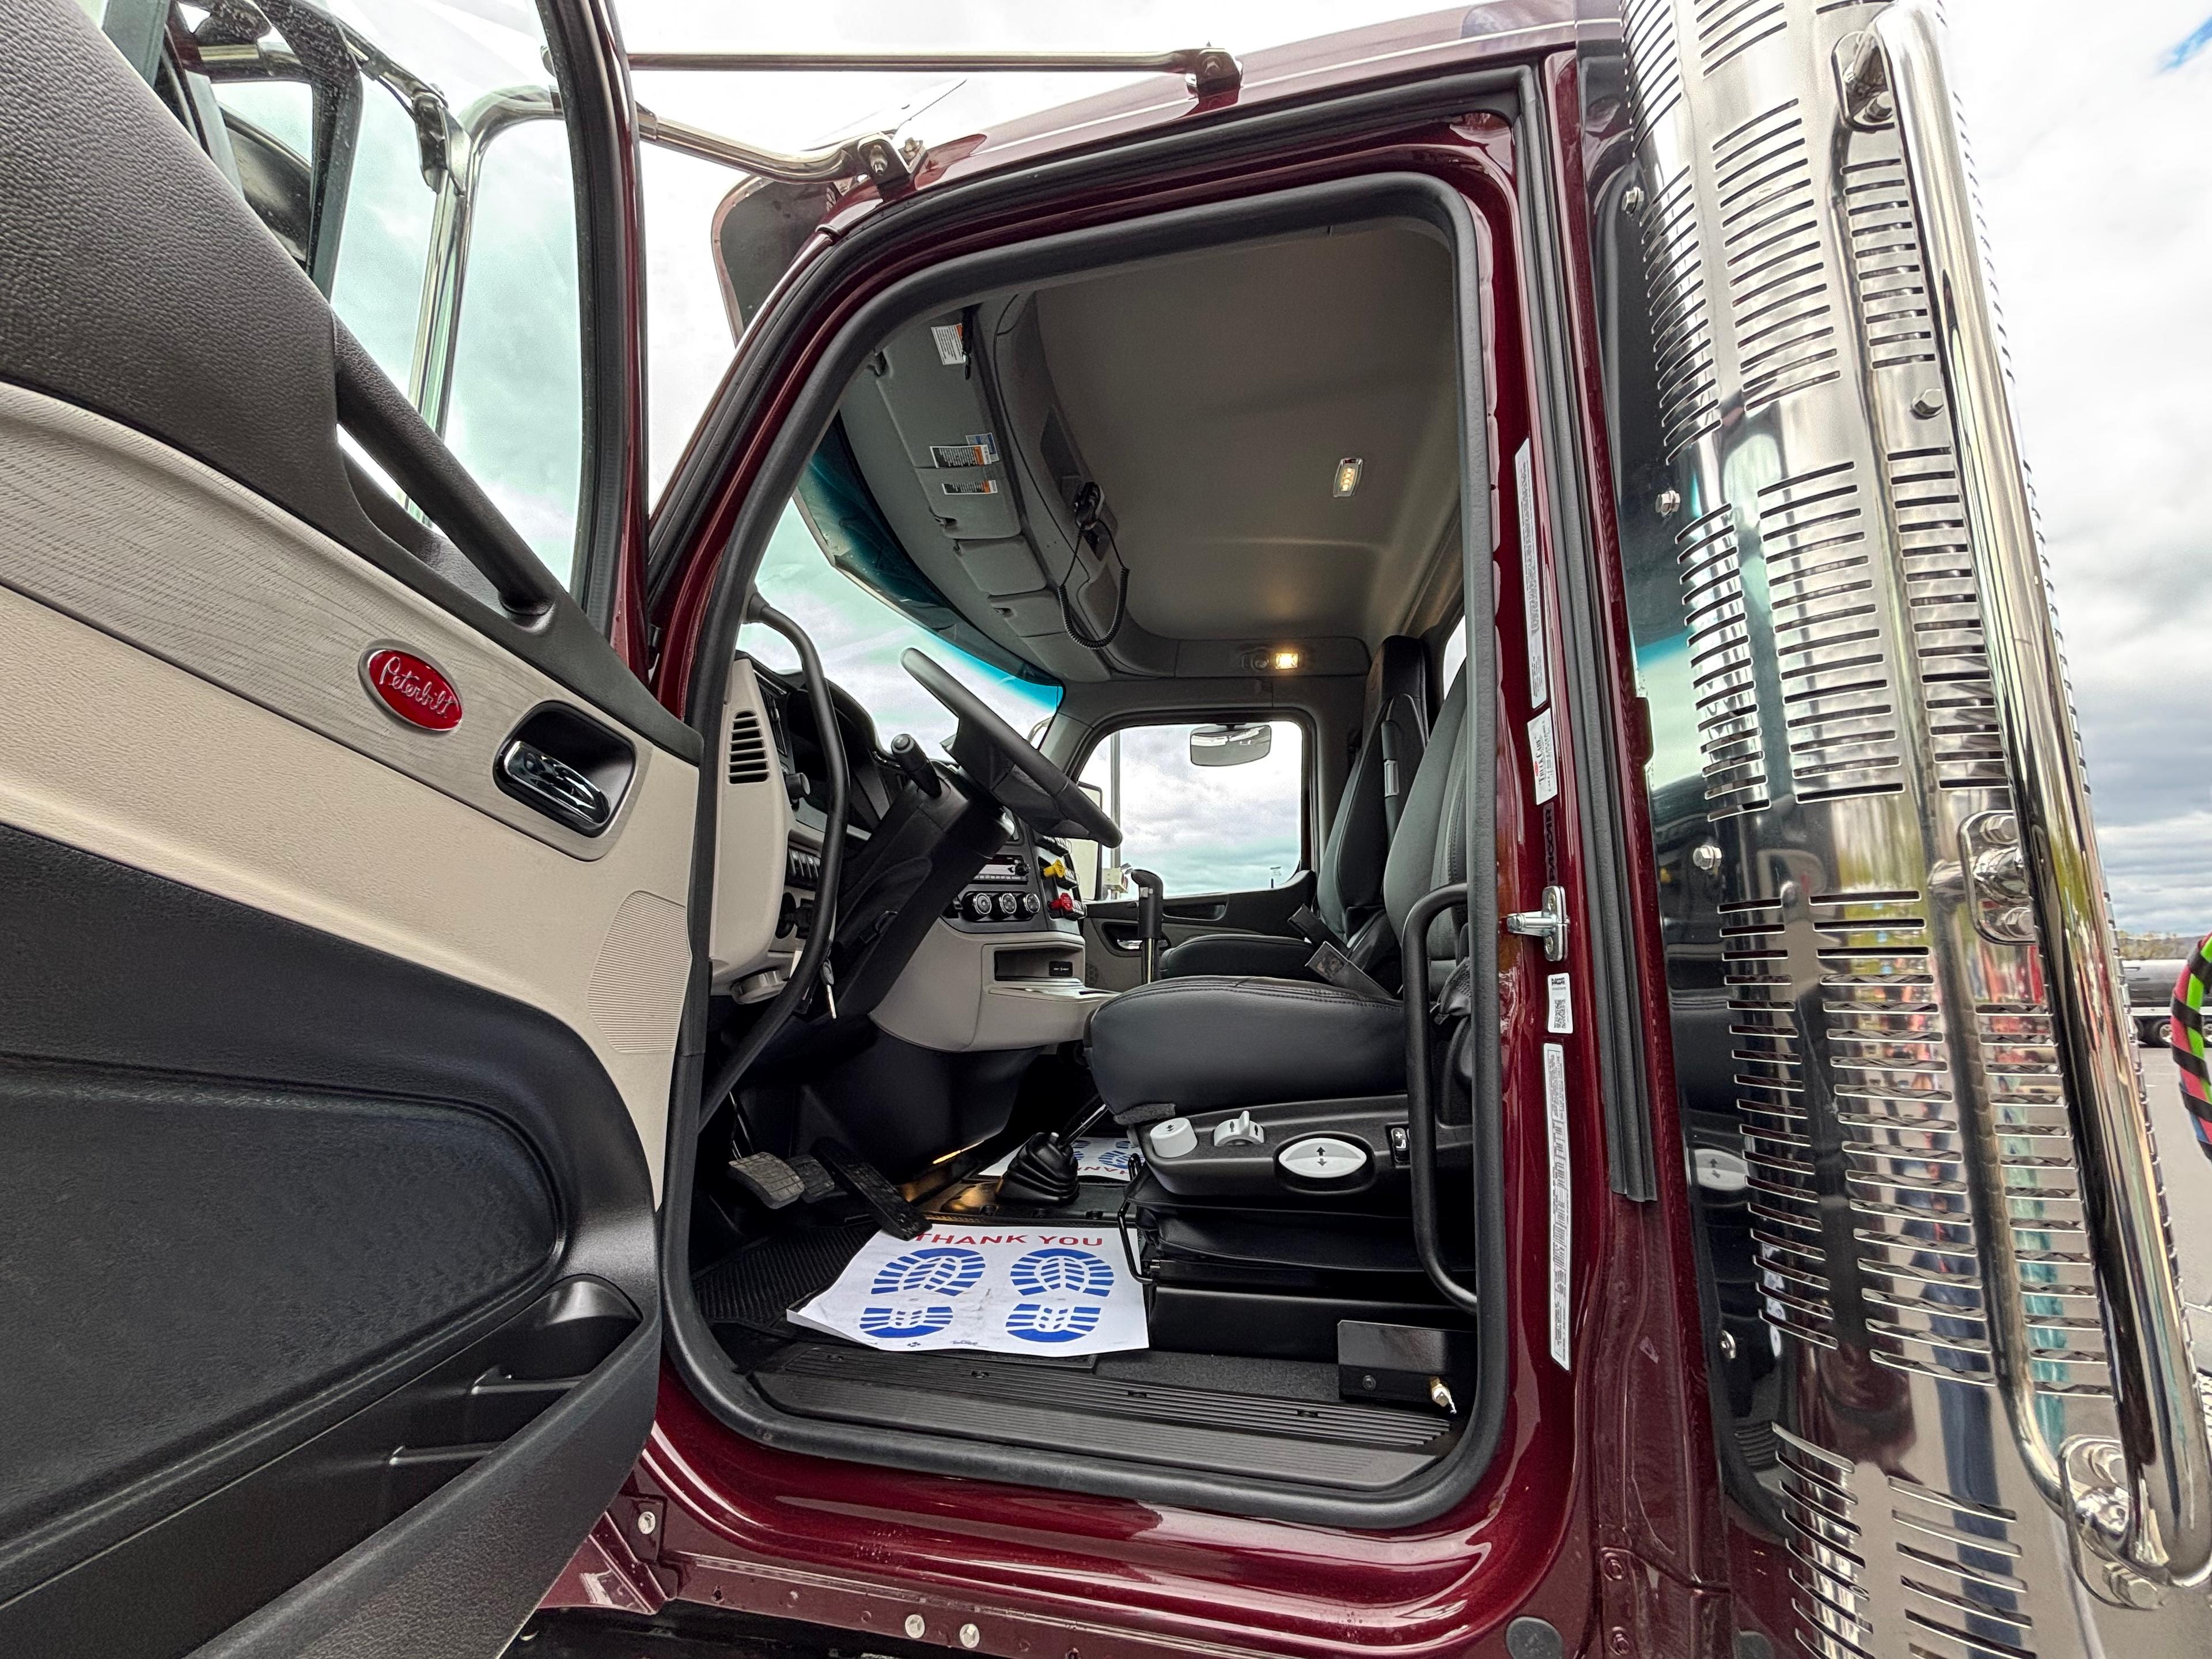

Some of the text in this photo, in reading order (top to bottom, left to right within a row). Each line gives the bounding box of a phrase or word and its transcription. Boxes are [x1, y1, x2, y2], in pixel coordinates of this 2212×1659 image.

[379, 656, 456, 715] Peterbilt
[1546, 809, 1555, 881] PACCAR
[915, 1233, 1103, 1246] THANK YOU
